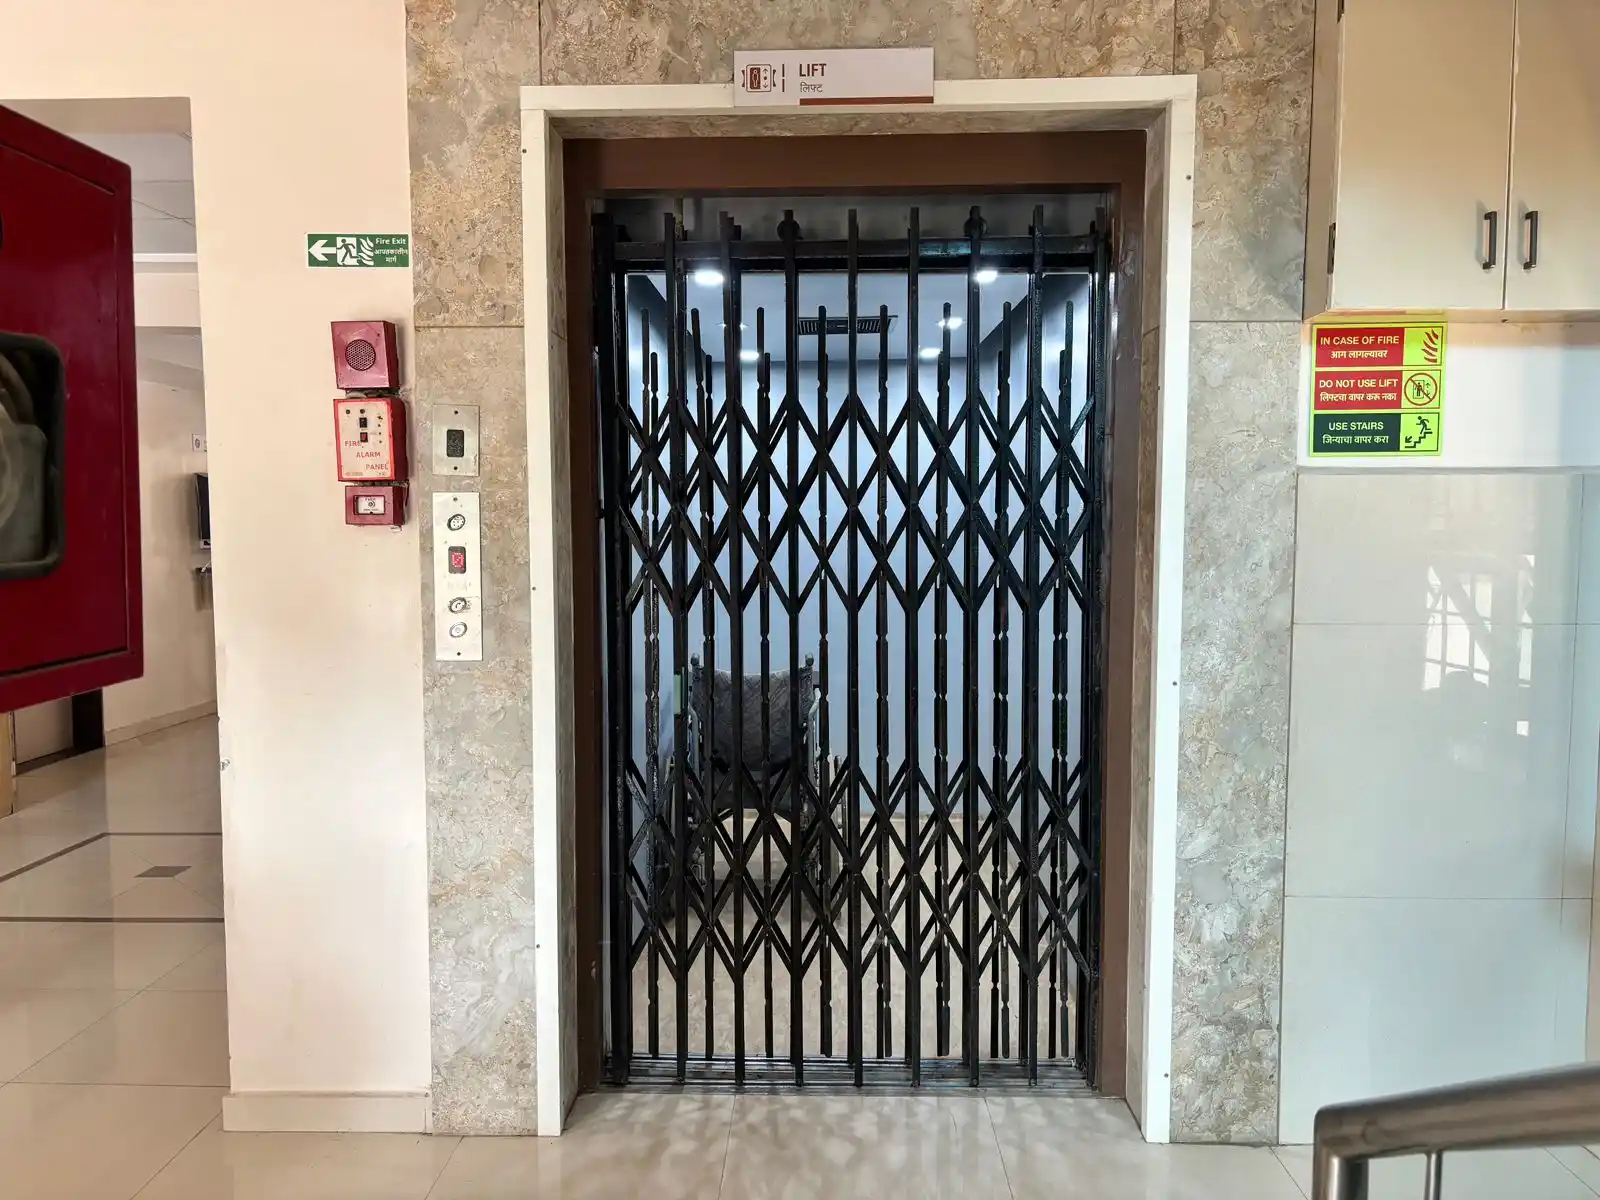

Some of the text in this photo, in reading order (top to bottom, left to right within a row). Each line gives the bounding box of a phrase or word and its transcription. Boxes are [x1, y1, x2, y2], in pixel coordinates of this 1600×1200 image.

[799, 63, 827, 77] LIFT
[800, 81, 823, 93] लिफ्ट
[1320, 335, 1400, 345] IN CASE OF FIRE
[1330, 349, 1388, 359] आग लागल्यावर
[1319, 378, 1398, 388] DO NOT USE LIFT
[1348, 393, 1365, 401] वापर
[1381, 392, 1397, 401] नका
[1328, 421, 1384, 431] USE STAIRS
[1354, 435, 1372, 444] वापर
[1374, 434, 1389, 443] करा
